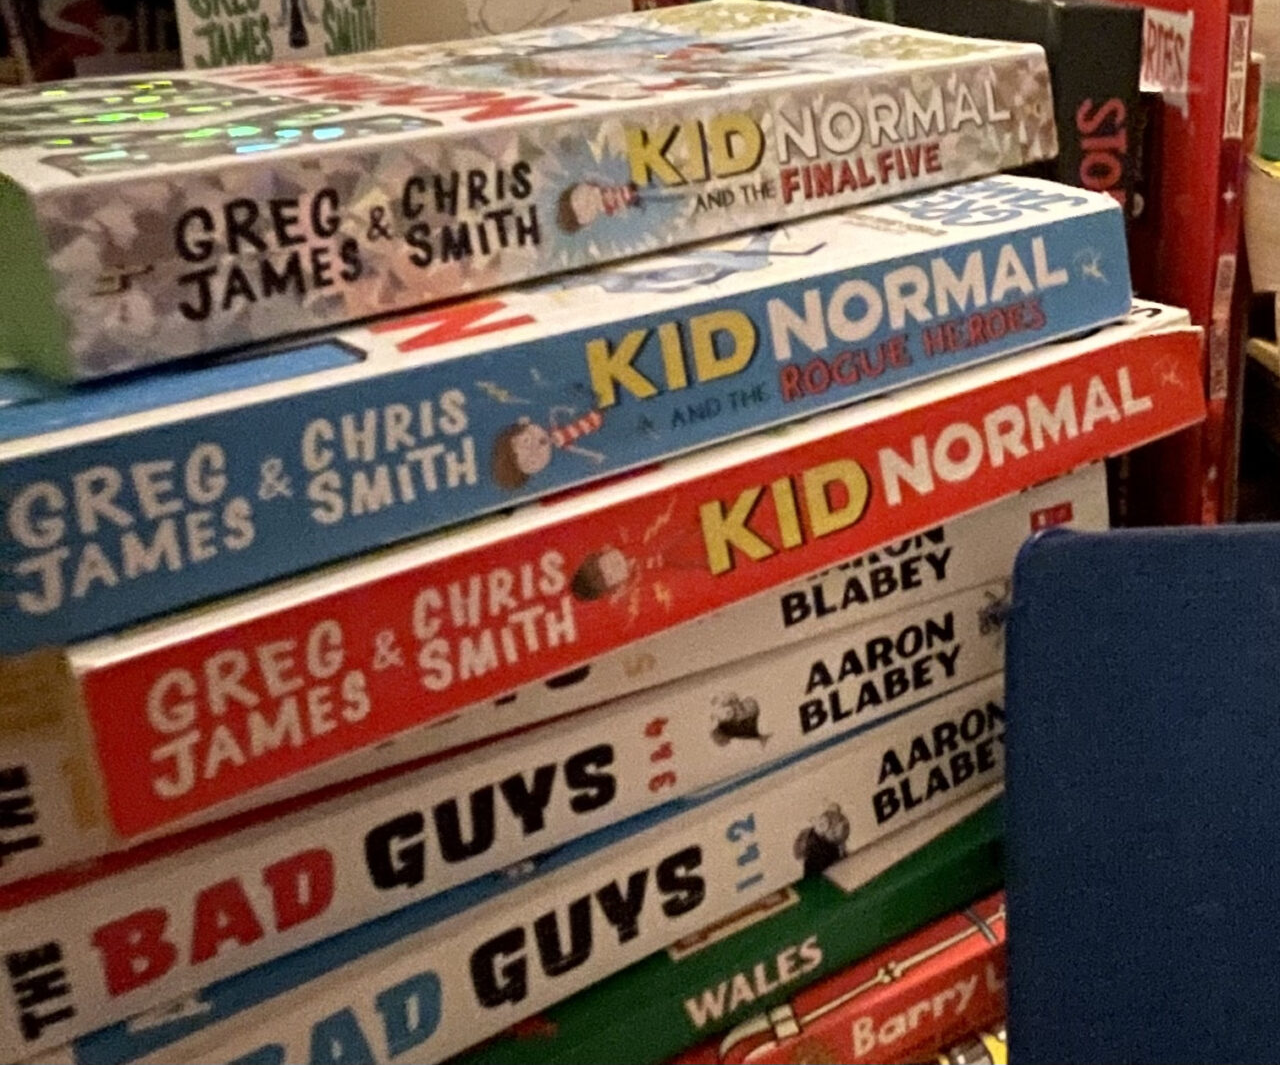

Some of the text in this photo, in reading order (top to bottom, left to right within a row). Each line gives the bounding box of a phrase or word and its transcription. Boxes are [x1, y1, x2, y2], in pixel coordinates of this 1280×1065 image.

[622, 77, 1011, 188] KID NORMAL
[695, 142, 943, 214] AND THE FINAL FIVE
[1076, 97, 1128, 207] STO
[173, 188, 341, 264] GREG
[367, 205, 391, 241] &
[402, 160, 533, 220] CHRIS
[179, 238, 363, 322] JAMES
[403, 204, 541, 269] SMITH
[586, 236, 1068, 410] KID NORMAL
[669, 298, 1047, 429] AND THE ROGUE HEROES
[303, 388, 468, 473] CHRIS
[700, 456, 871, 578] KID
[879, 365, 1154, 507] NORMAL
[6, 442, 228, 549] GREG
[259, 459, 295, 500] &
[307, 437, 480, 525] SMITH
[14, 496, 256, 615] JAMES
[411, 550, 566, 641] CHRIS
[781, 547, 954, 629] BLABEY
[145, 619, 345, 736] GREG
[371, 629, 405, 673] &
[418, 598, 578, 692] SMITH
[798, 645, 961, 735] BLABEY
[804, 611, 956, 695] AARON
[150, 669, 372, 802] JAMES
[871, 736, 1007, 826] BLABE
[90, 743, 617, 998] BAD GUYS
[5, 940, 77, 1043] THE
[224, 845, 706, 1065] AD GUYS
[683, 935, 824, 1029] WALES
[850, 965, 977, 1058] Barry
